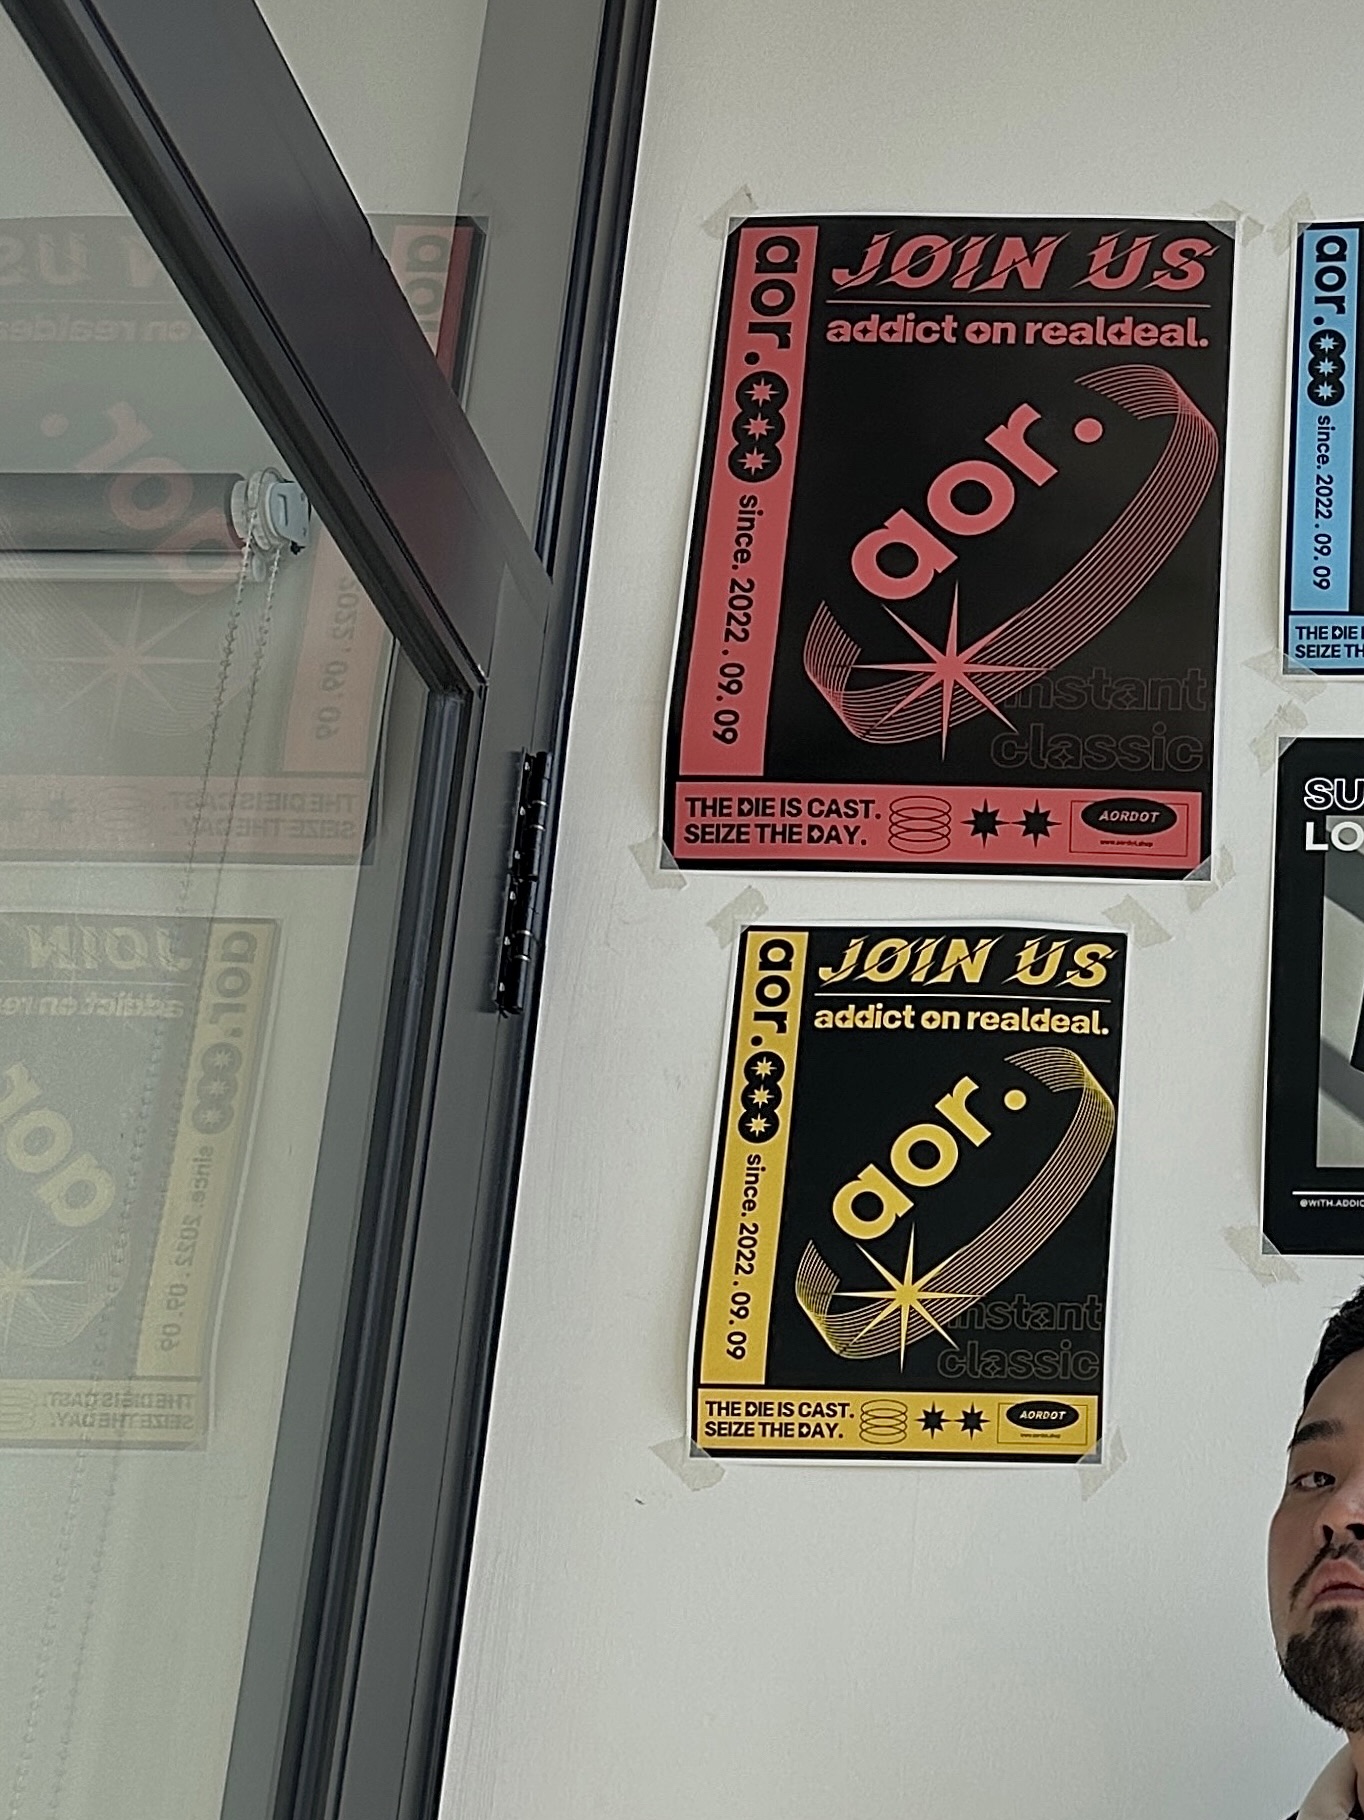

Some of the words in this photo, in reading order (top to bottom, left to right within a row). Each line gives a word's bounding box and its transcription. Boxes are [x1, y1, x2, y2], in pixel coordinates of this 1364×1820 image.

[832, 232, 1070, 293] JOIN
[1070, 229, 1220, 292] US
[825, 312, 957, 343] addict
[965, 324, 1016, 344] on
[1025, 316, 1209, 347] realdeal.
[1317, 415, 1336, 469] since.
[851, 403, 1103, 600] aor.
[731, 495, 764, 570] since.
[1295, 626, 1328, 640] THE
[1332, 626, 1358, 640] DIE
[1295, 644, 1340, 658] SEIZE
[1003, 667, 1207, 711] nstant
[991, 721, 1203, 772] classic
[685, 798, 733, 817] THE
[738, 798, 775, 817] DIE
[780, 798, 802, 818] IS
[807, 799, 881, 819] CAST.
[1098, 811, 1160, 823] AORDOT
[684, 824, 750, 844] SEIZE
[754, 824, 802, 844] THE
[807, 824, 867, 845] DAY.
[818, 935, 1005, 987] JOIN
[1001, 935, 1118, 987] US
[814, 1003, 915, 1029] addict
[920, 1011, 960, 1029] on
[967, 1007, 1110, 1034] realdeal.
[832, 1076, 1026, 1240] aor.
[741, 1154, 766, 1217] since.
[948, 1294, 1102, 1330] nstant
[937, 1339, 1099, 1380] classic
[705, 1401, 741, 1416] THE
[745, 1402, 774, 1417] DIE
[777, 1402, 794, 1417] IS
[799, 1402, 854, 1418] CAST.
[1020, 1411, 1066, 1420] AORDOT
[705, 1422, 754, 1437] SEIZE
[758, 1422, 794, 1437] THE
[799, 1423, 843, 1438] DAY.
